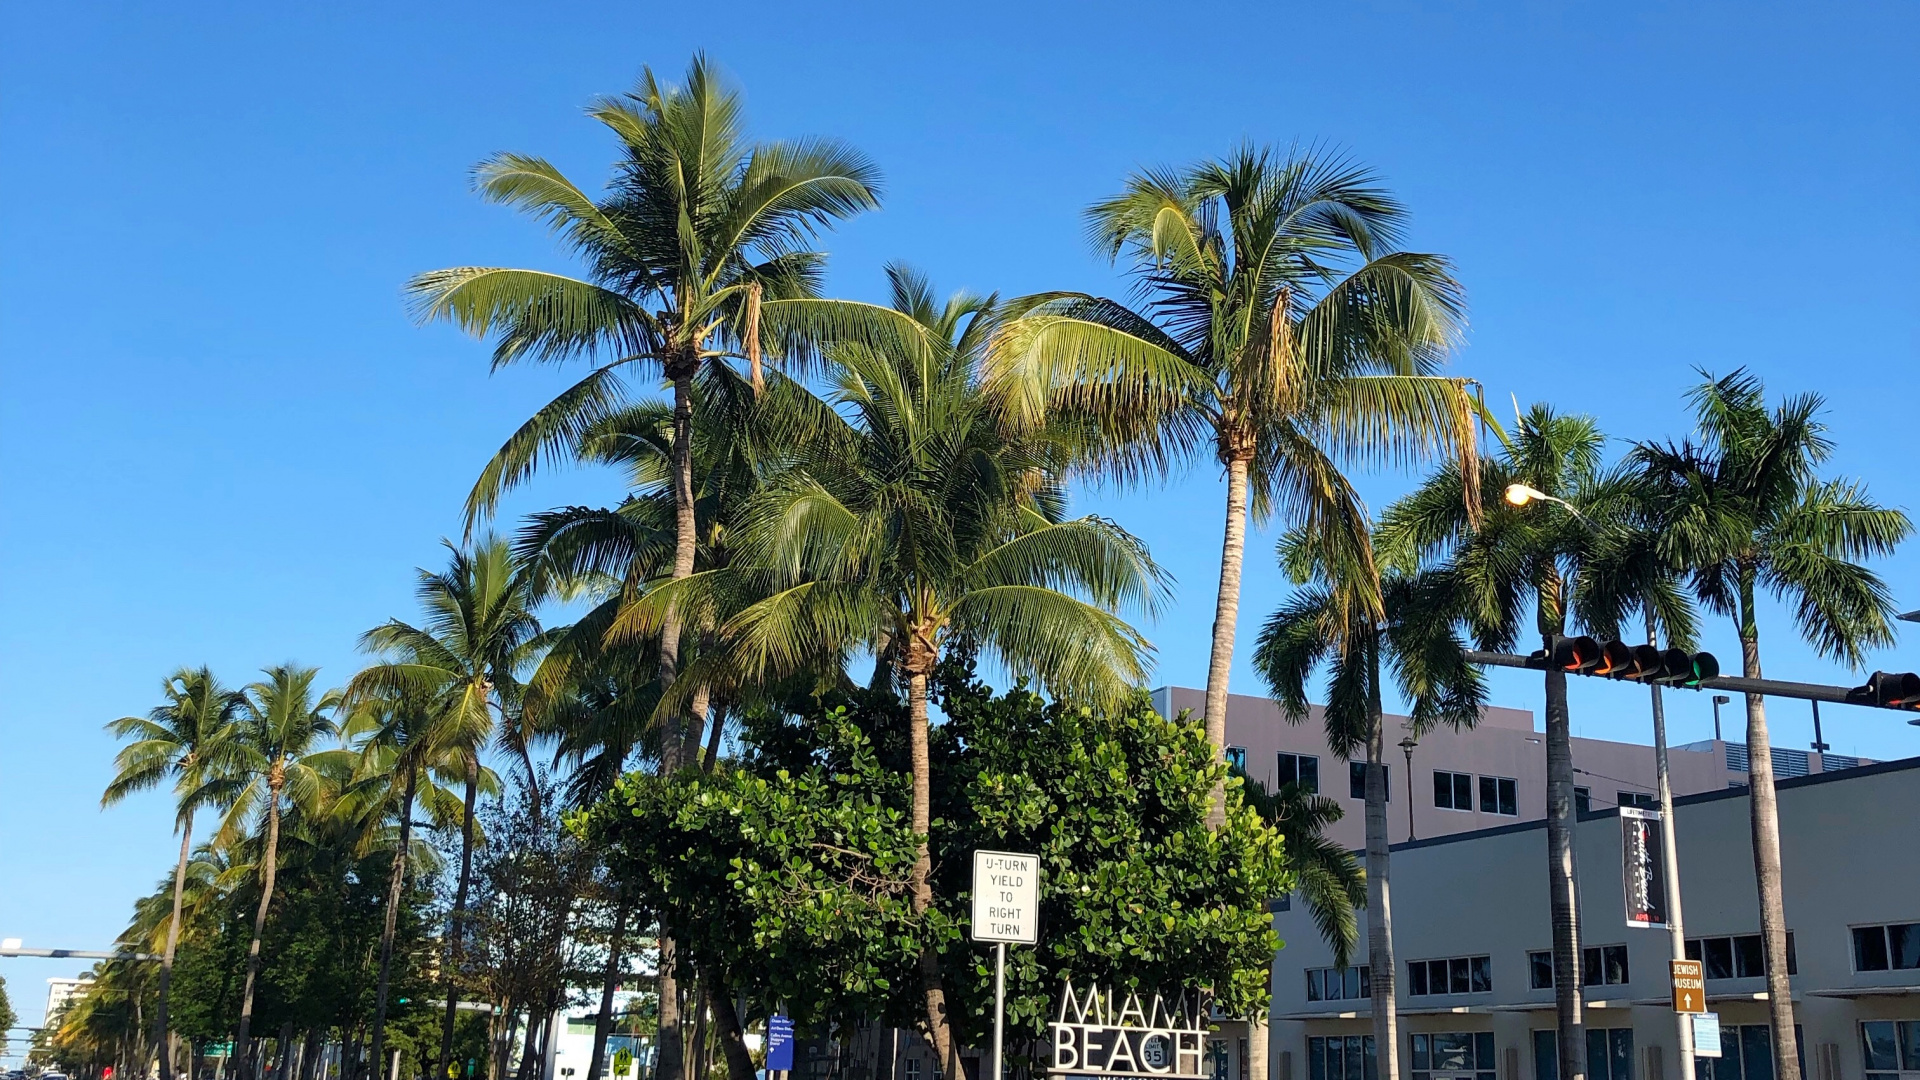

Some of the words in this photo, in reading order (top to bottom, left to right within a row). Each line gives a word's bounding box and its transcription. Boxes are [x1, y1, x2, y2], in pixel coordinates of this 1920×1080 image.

[986, 858, 1028, 872] U-TURN
[1632, 821, 1641, 909] TRIATHLON
[990, 874, 1024, 888] YIELD
[1640, 866, 1656, 912] Beach
[999, 891, 1013, 903] TO
[989, 906, 1022, 919] RIGHT
[990, 923, 1020, 936] TURN
[1673, 964, 1699, 976] JEWISH
[1059, 980, 1201, 1031] MIAMI
[1055, 1026, 1202, 1075] BEACH
[1144, 1050, 1162, 1062] 35
